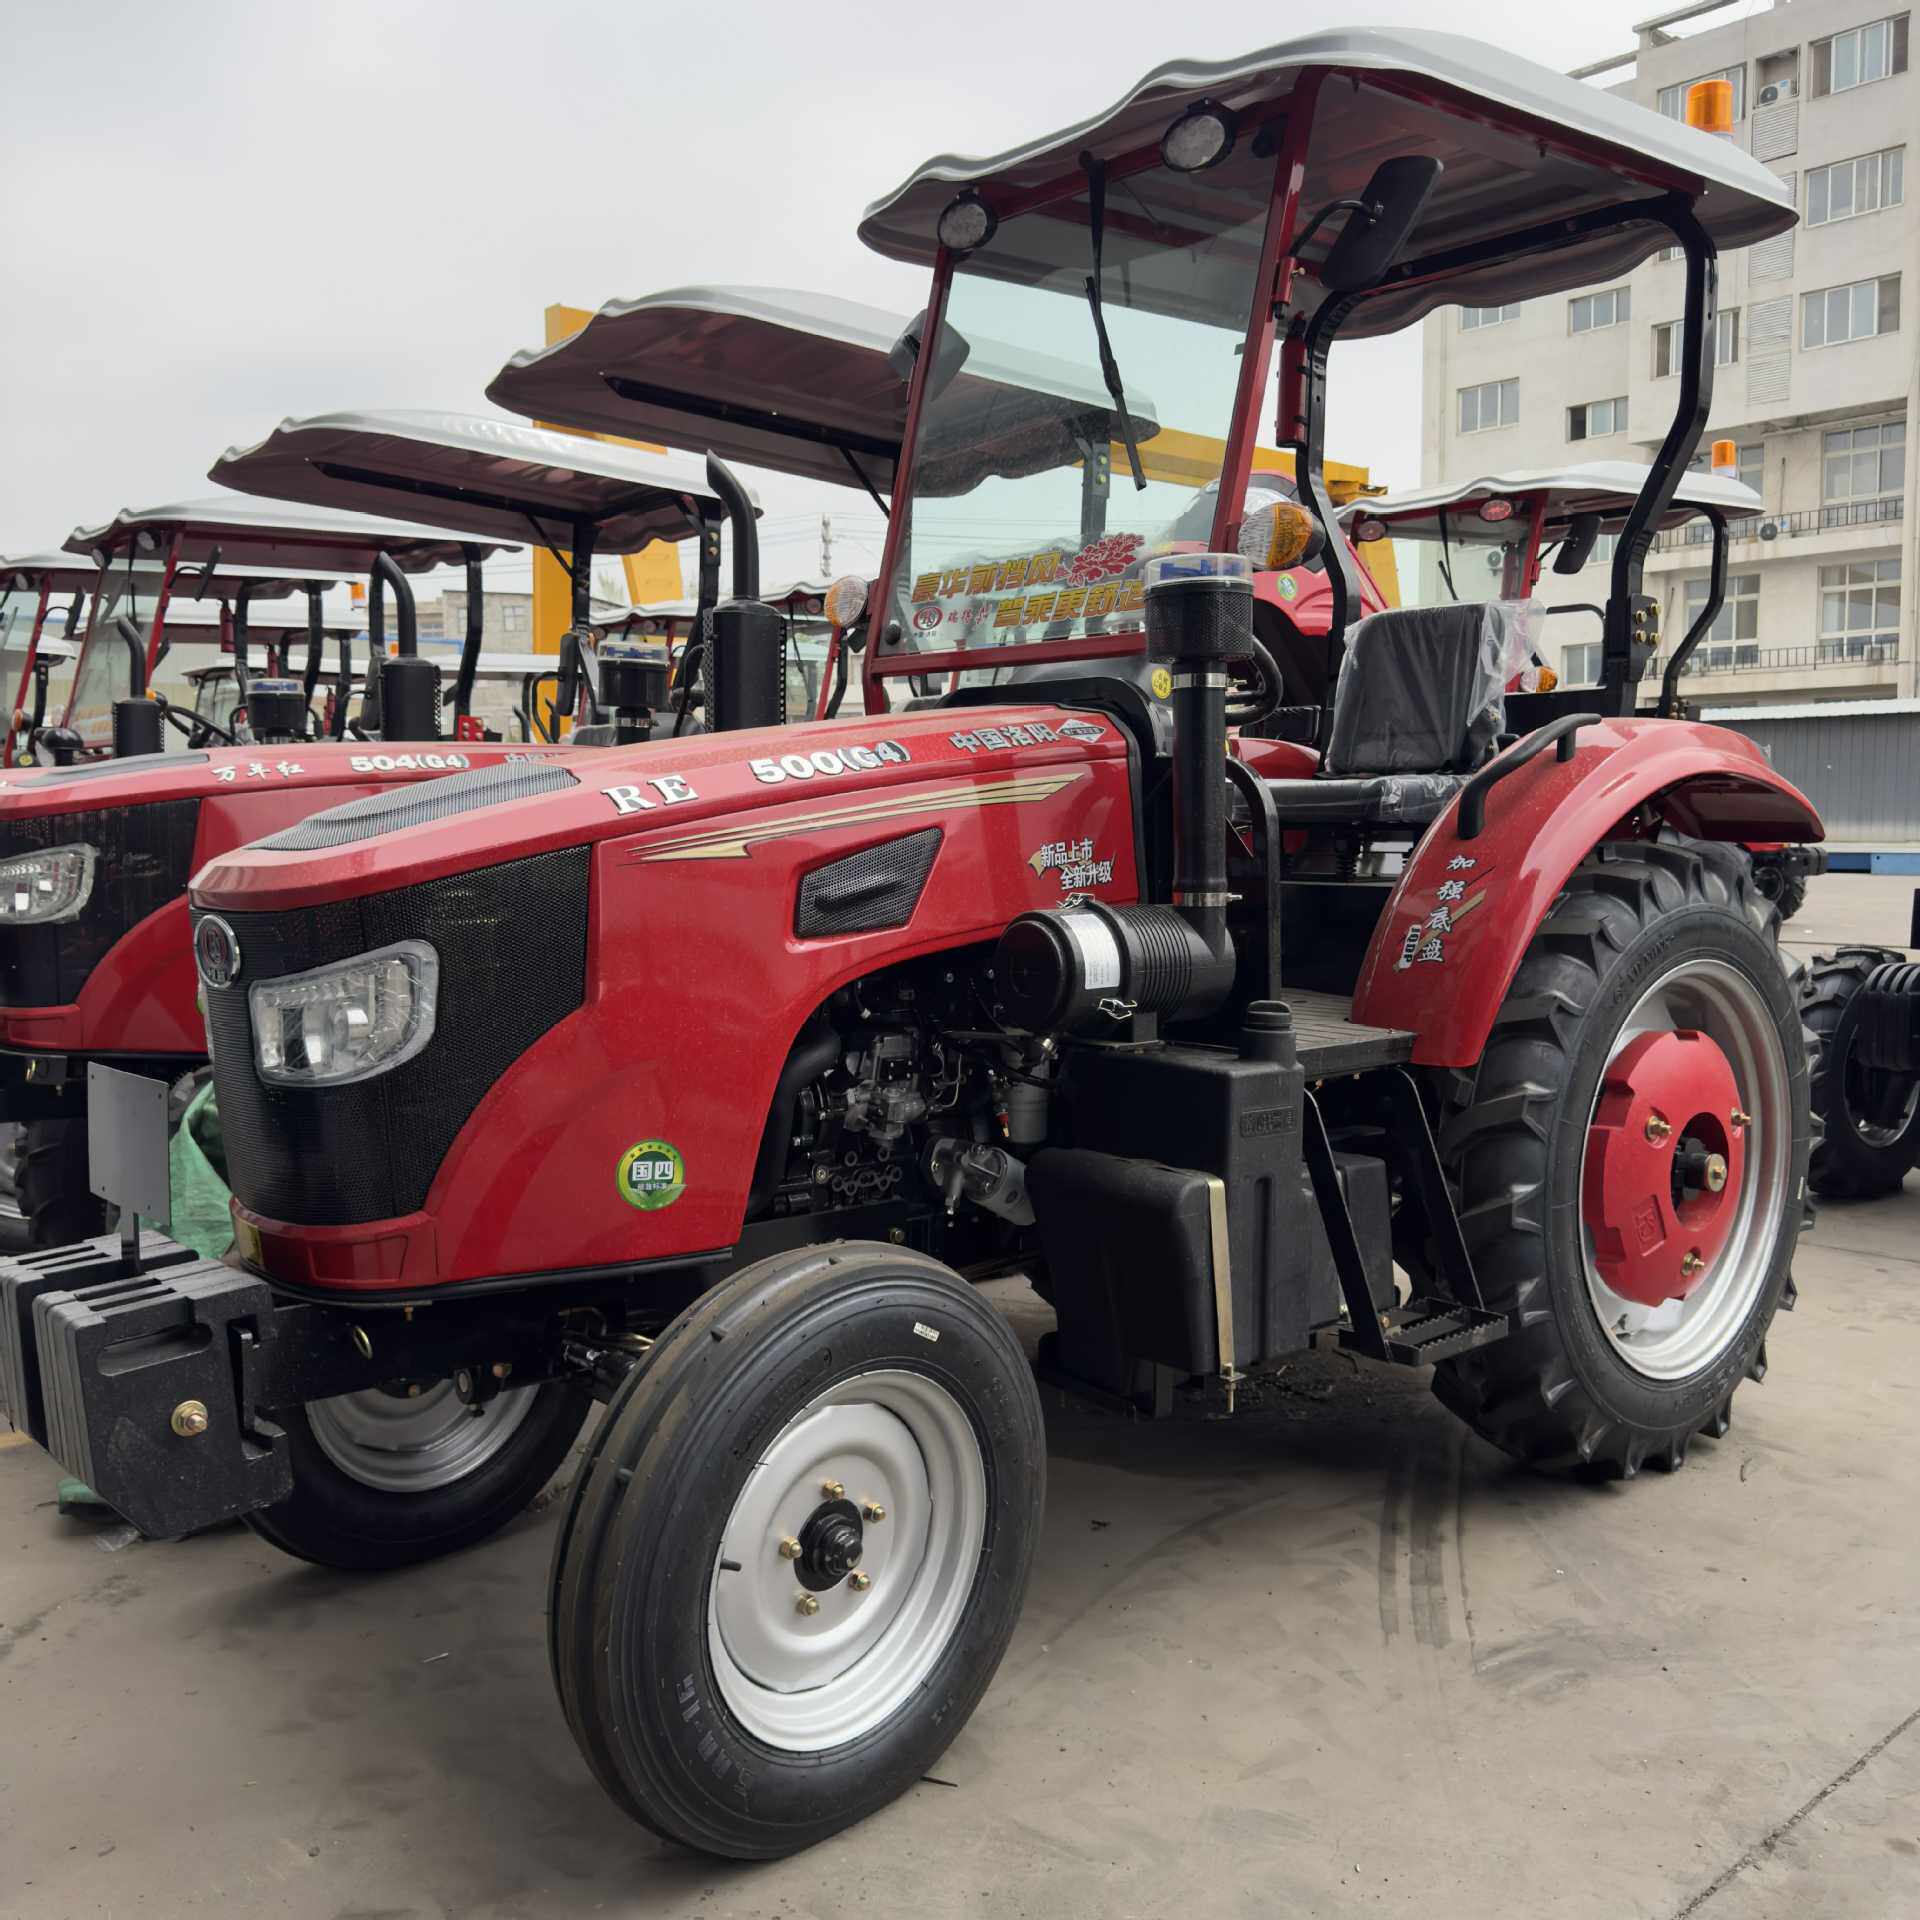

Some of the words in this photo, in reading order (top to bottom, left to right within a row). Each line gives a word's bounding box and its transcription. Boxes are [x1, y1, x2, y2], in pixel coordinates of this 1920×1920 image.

[911, 551, 1063, 603] 豪华前挡风
[949, 722, 1060, 753] 中国洛阳
[210, 760, 305, 783] 万年红
[349, 753, 470, 773] 504(G4)
[749, 739, 911, 784] 500(G4)
[1040, 837, 1094, 868] 新品上市
[1060, 860, 1113, 891] 全新升级
[1416, 854, 1477, 963] 加强底盘
[632, 1160, 674, 1182] 国四
